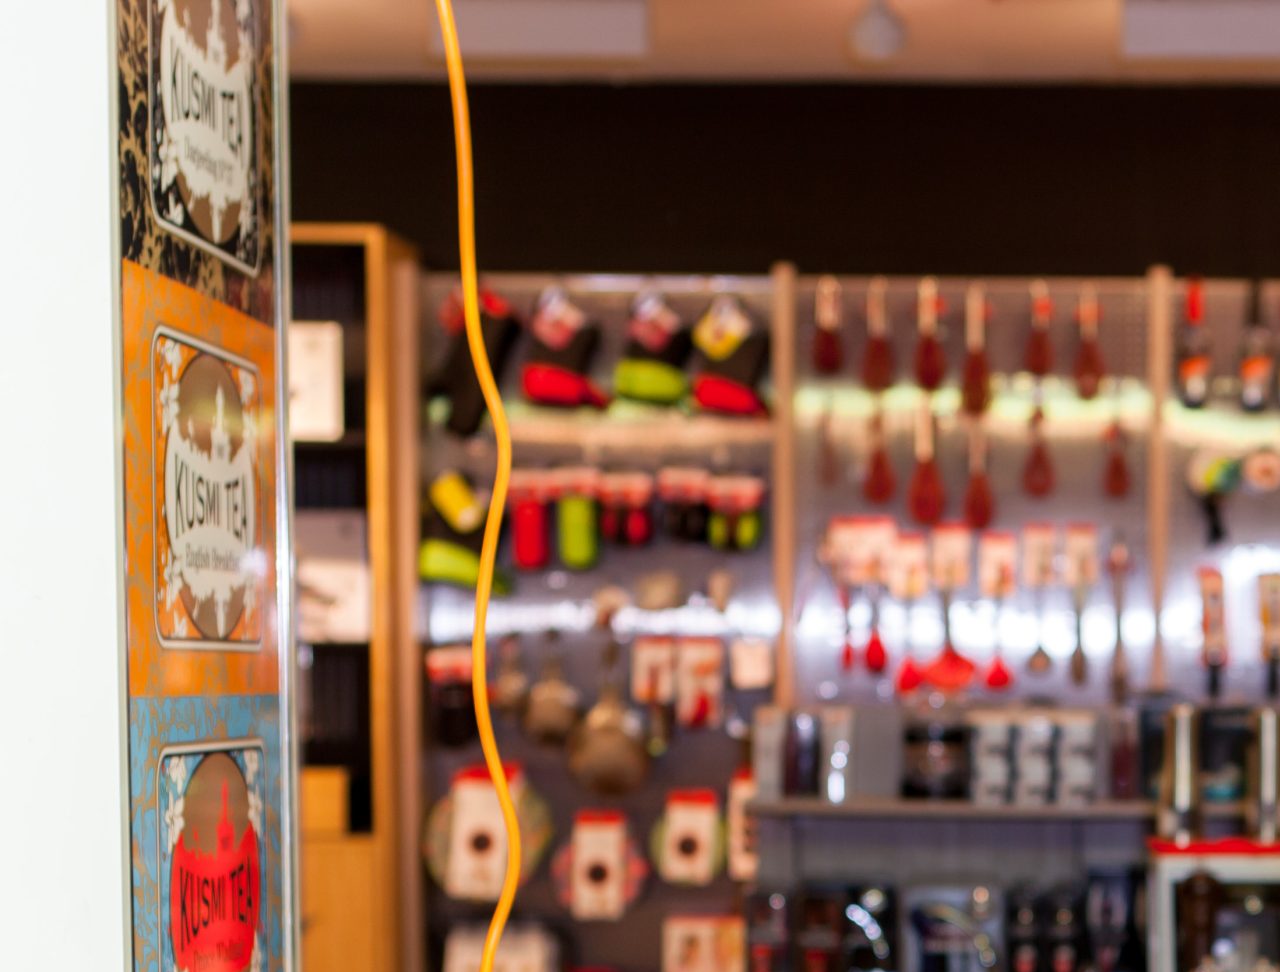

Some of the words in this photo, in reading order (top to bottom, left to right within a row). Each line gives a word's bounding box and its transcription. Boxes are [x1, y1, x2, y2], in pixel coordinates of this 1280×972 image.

[170, 36, 217, 131] KUSMI
[174, 453, 220, 538] KUSMI
[225, 474, 248, 548] TEA
[180, 866, 226, 952] KUSMI
[230, 855, 254, 926] TEA
